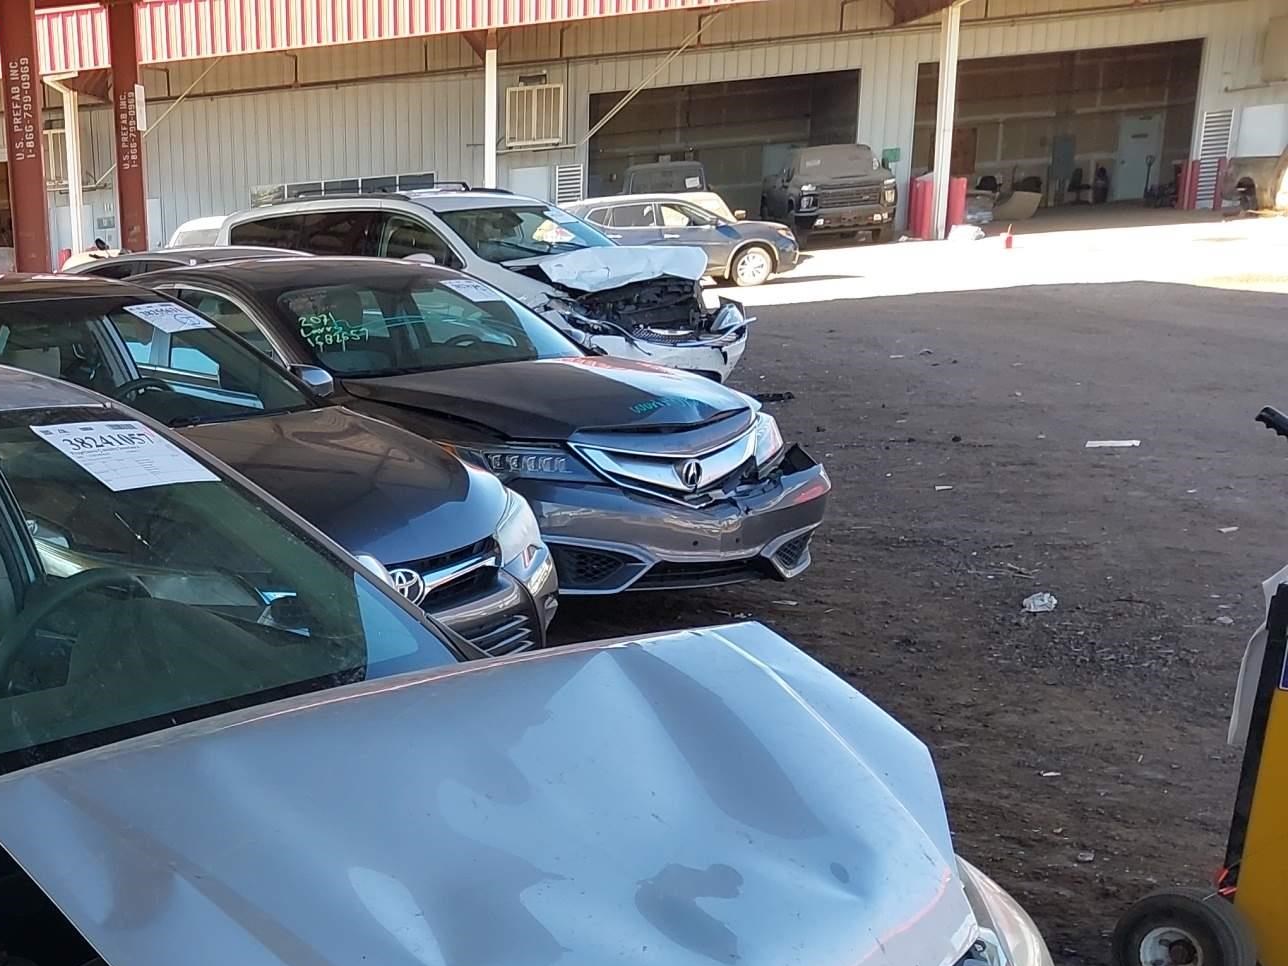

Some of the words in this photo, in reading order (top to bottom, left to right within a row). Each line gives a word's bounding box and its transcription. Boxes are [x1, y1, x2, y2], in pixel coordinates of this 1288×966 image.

[10, 86, 23, 132] PREFAB
[19, 57, 36, 159] 1-866-799-0969
[120, 113, 129, 148] PREFAB
[15, 137, 25, 161] U.S.
[122, 151, 130, 170] U.S.
[62, 433, 154, 451] 38241057
